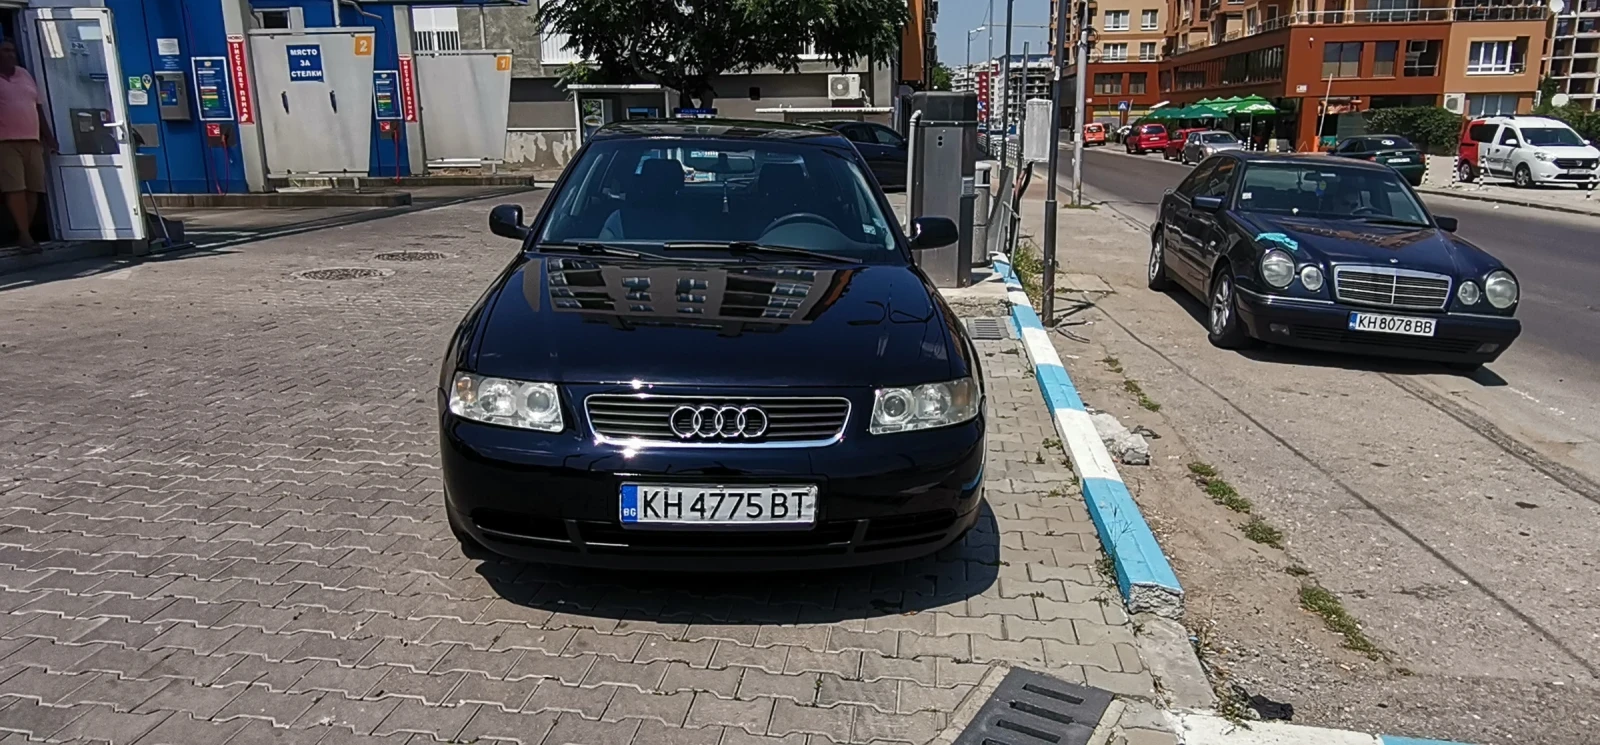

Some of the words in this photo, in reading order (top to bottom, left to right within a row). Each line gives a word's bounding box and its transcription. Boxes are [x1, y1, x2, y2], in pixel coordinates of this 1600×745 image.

[360, 40, 368, 52] 2
[233, 43, 244, 89] ПИСТОЛЕТ
[500, 58, 506, 69] 1
[643, 491, 683, 519] KH
[690, 492, 764, 520] 4775
[770, 492, 809, 519] BT
[623, 508, 637, 517] BG
